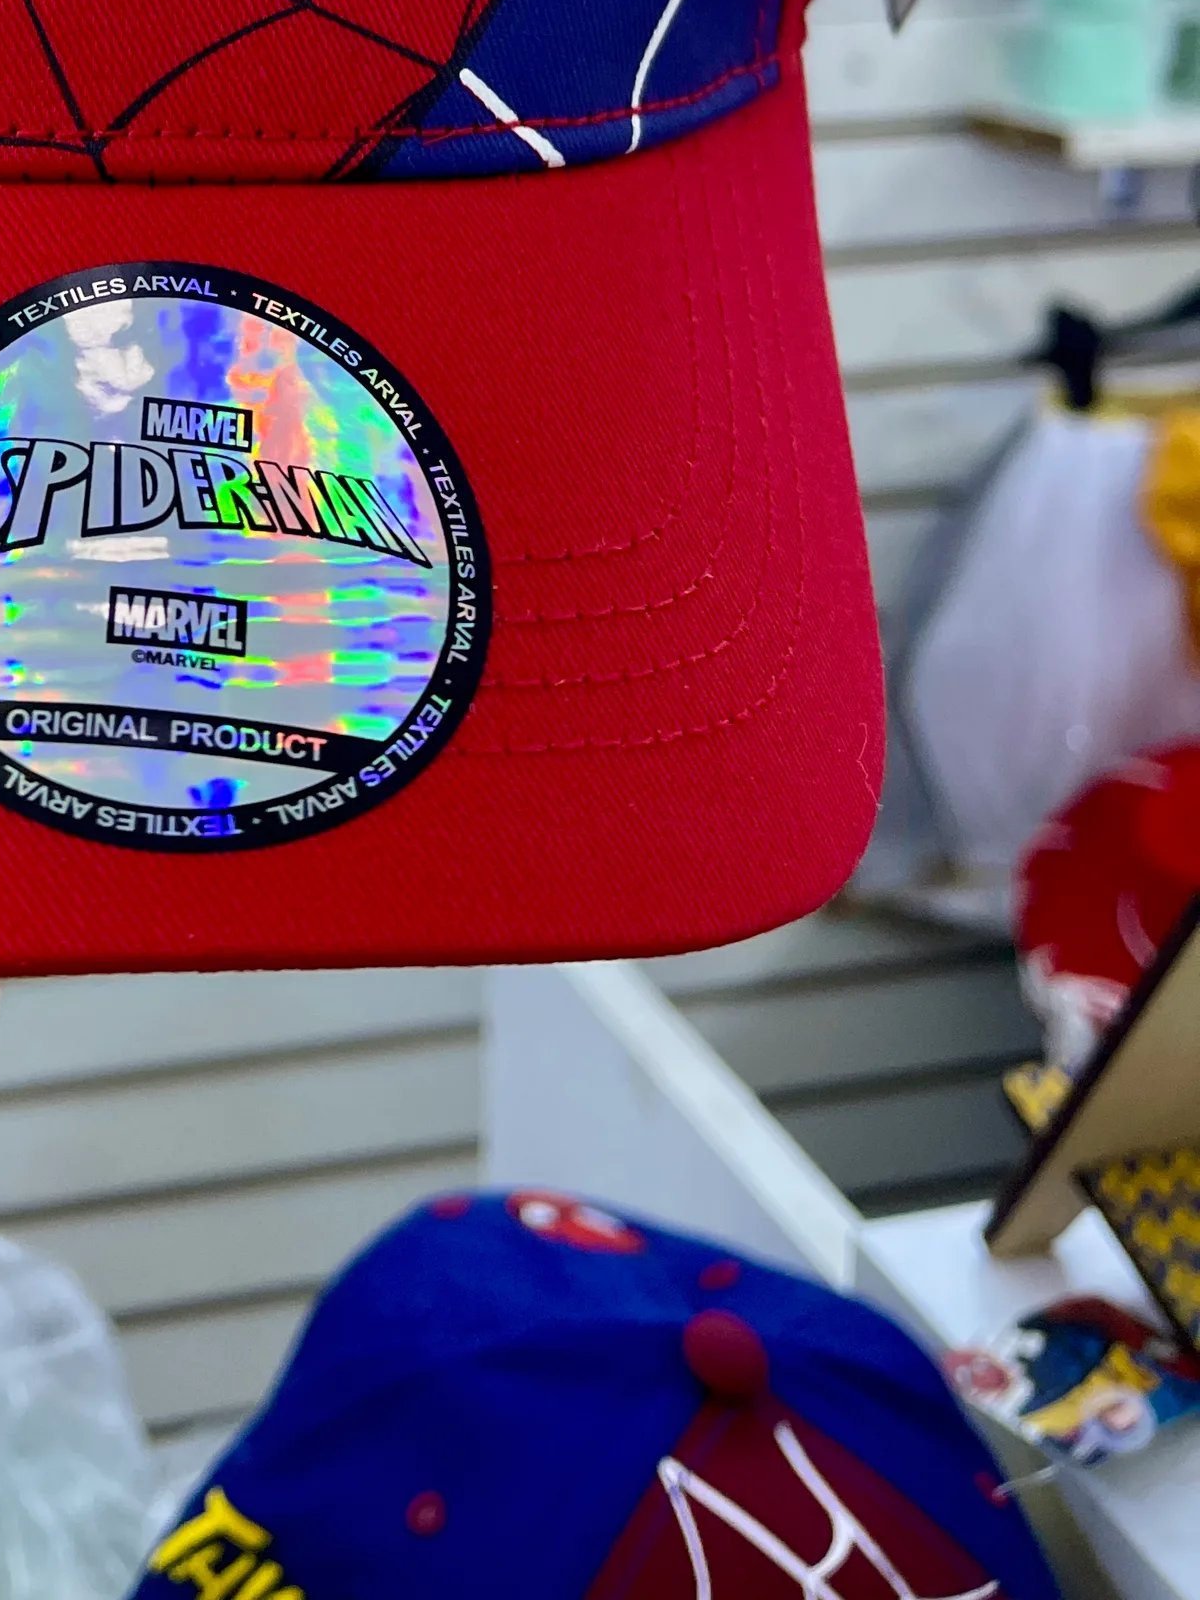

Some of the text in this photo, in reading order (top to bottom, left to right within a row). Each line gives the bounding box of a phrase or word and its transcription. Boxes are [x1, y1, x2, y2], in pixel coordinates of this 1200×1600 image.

[8, 275, 218, 328] TEXTILES ARVAL
[252, 292, 422, 440] TEXTILES ARVAL
[146, 402, 250, 448] MARVEL
[429, 459, 476, 664] TEXTILES ARVAL
[113, 593, 243, 650] MARVEL
[6, 708, 327, 762] ORIGINAL PRODUCT
[265, 694, 452, 825] TEXTILES ARVAL
[3, 764, 244, 837] TEXTILES ARVAL
